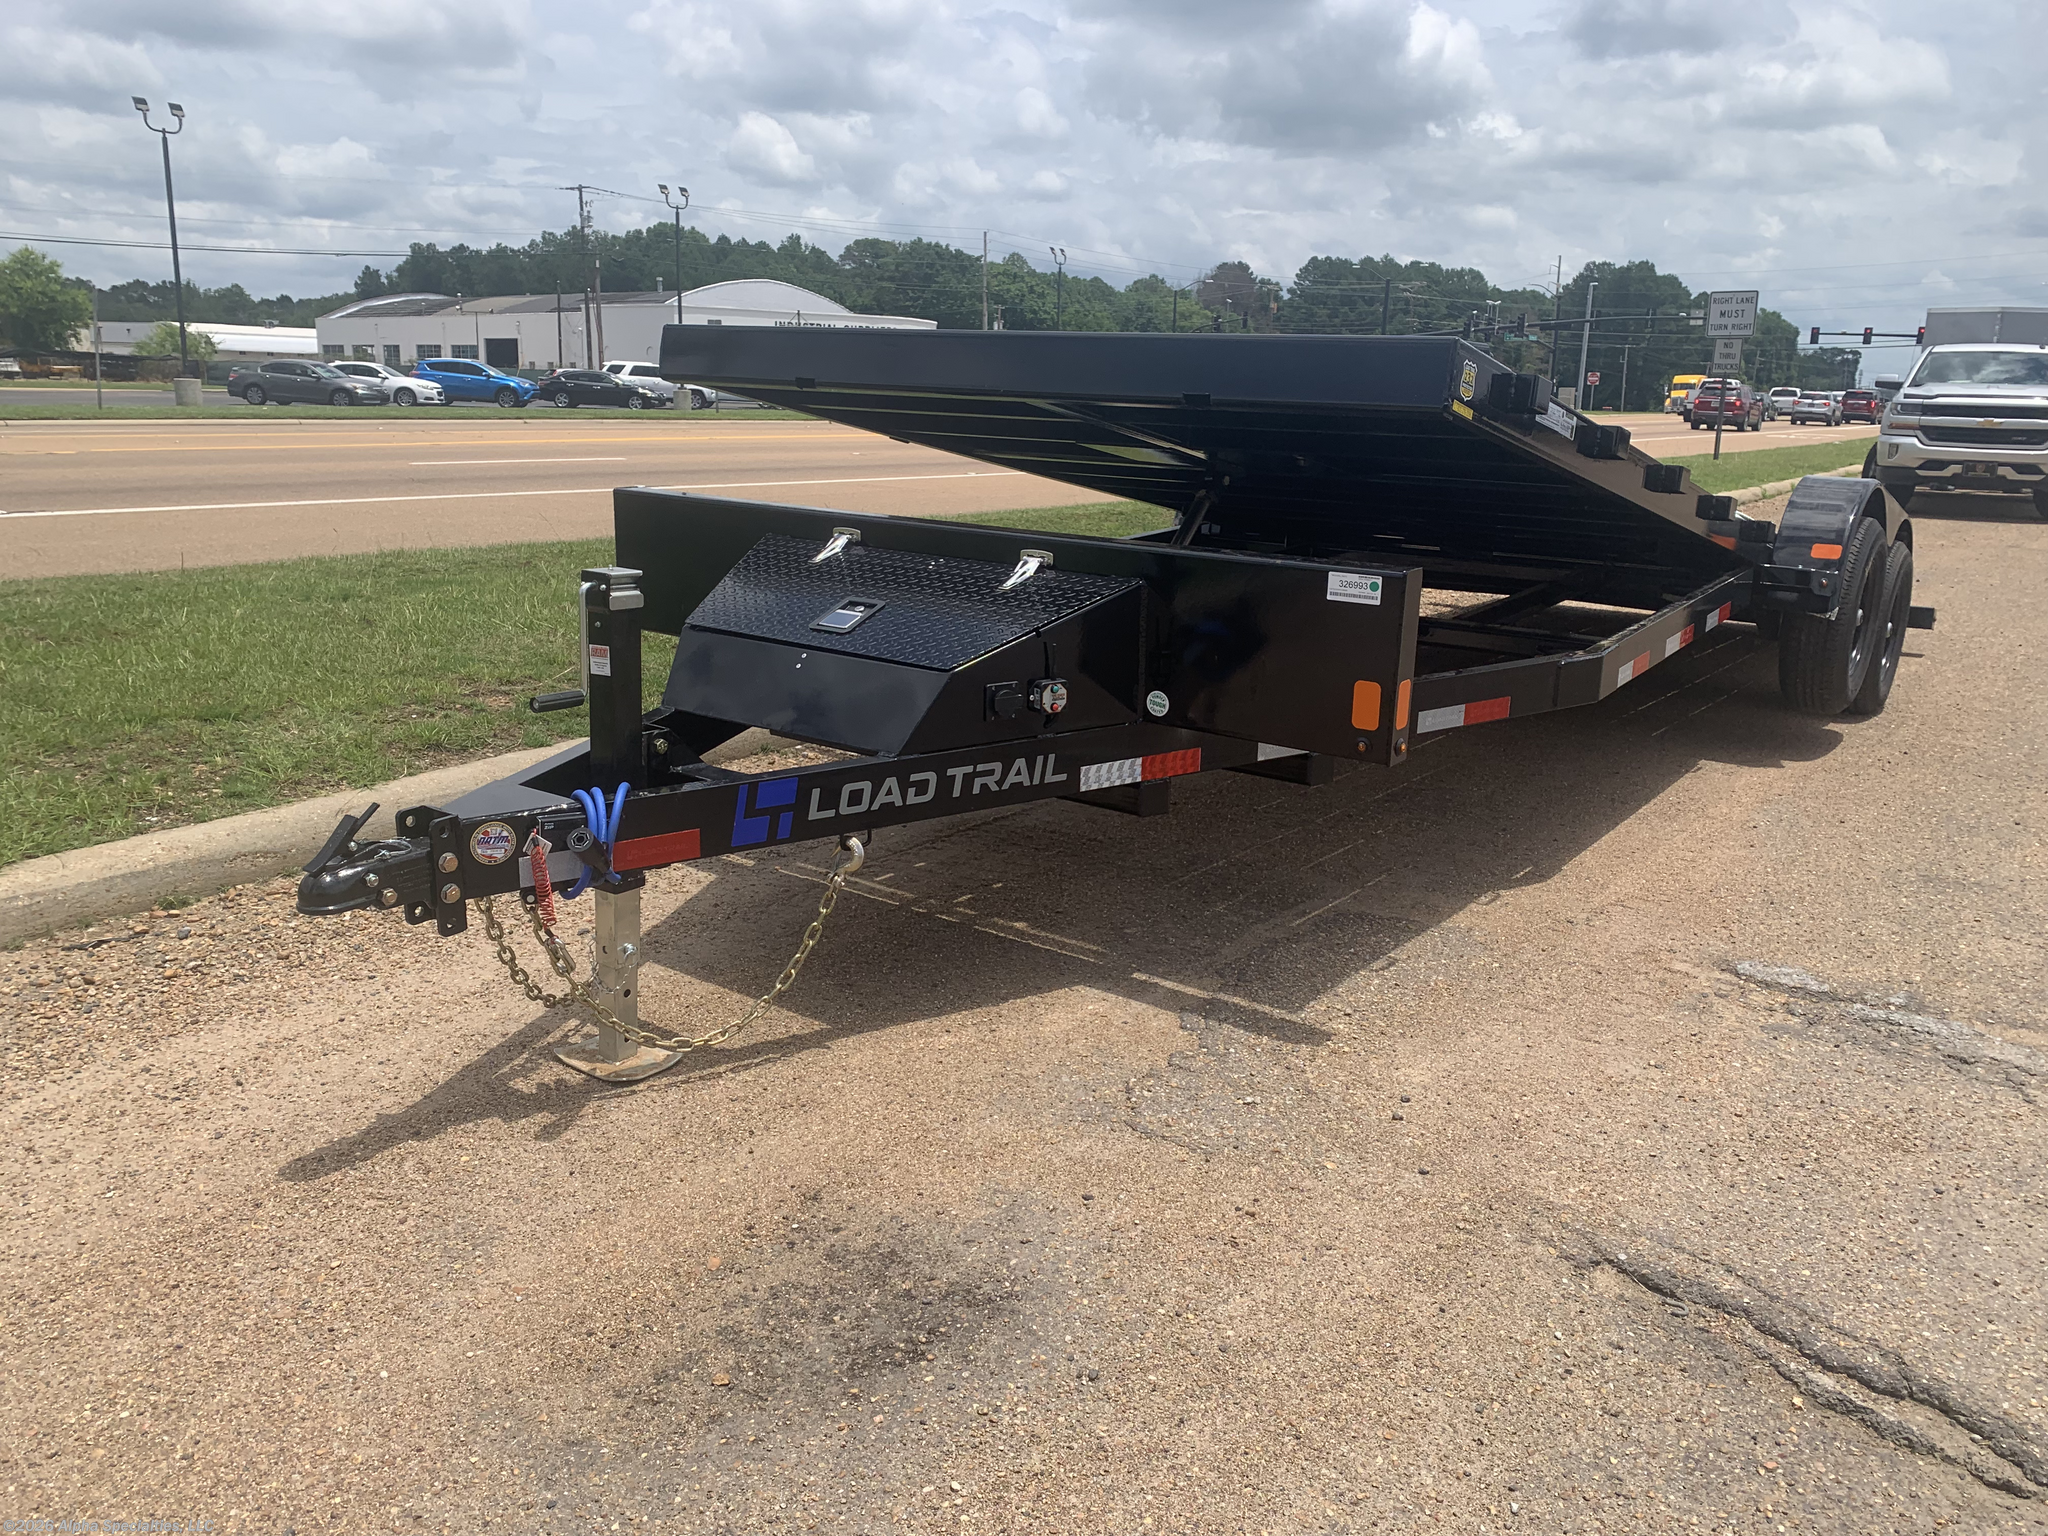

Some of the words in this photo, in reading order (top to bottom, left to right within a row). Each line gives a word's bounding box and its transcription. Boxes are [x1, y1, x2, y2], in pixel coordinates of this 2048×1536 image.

[1719, 309, 1745, 318] MUST
[1339, 580, 1368, 590] 326993
[591, 649, 608, 657] RAM
[808, 772, 938, 821] LOAD
[946, 753, 1068, 798] TRAIL
